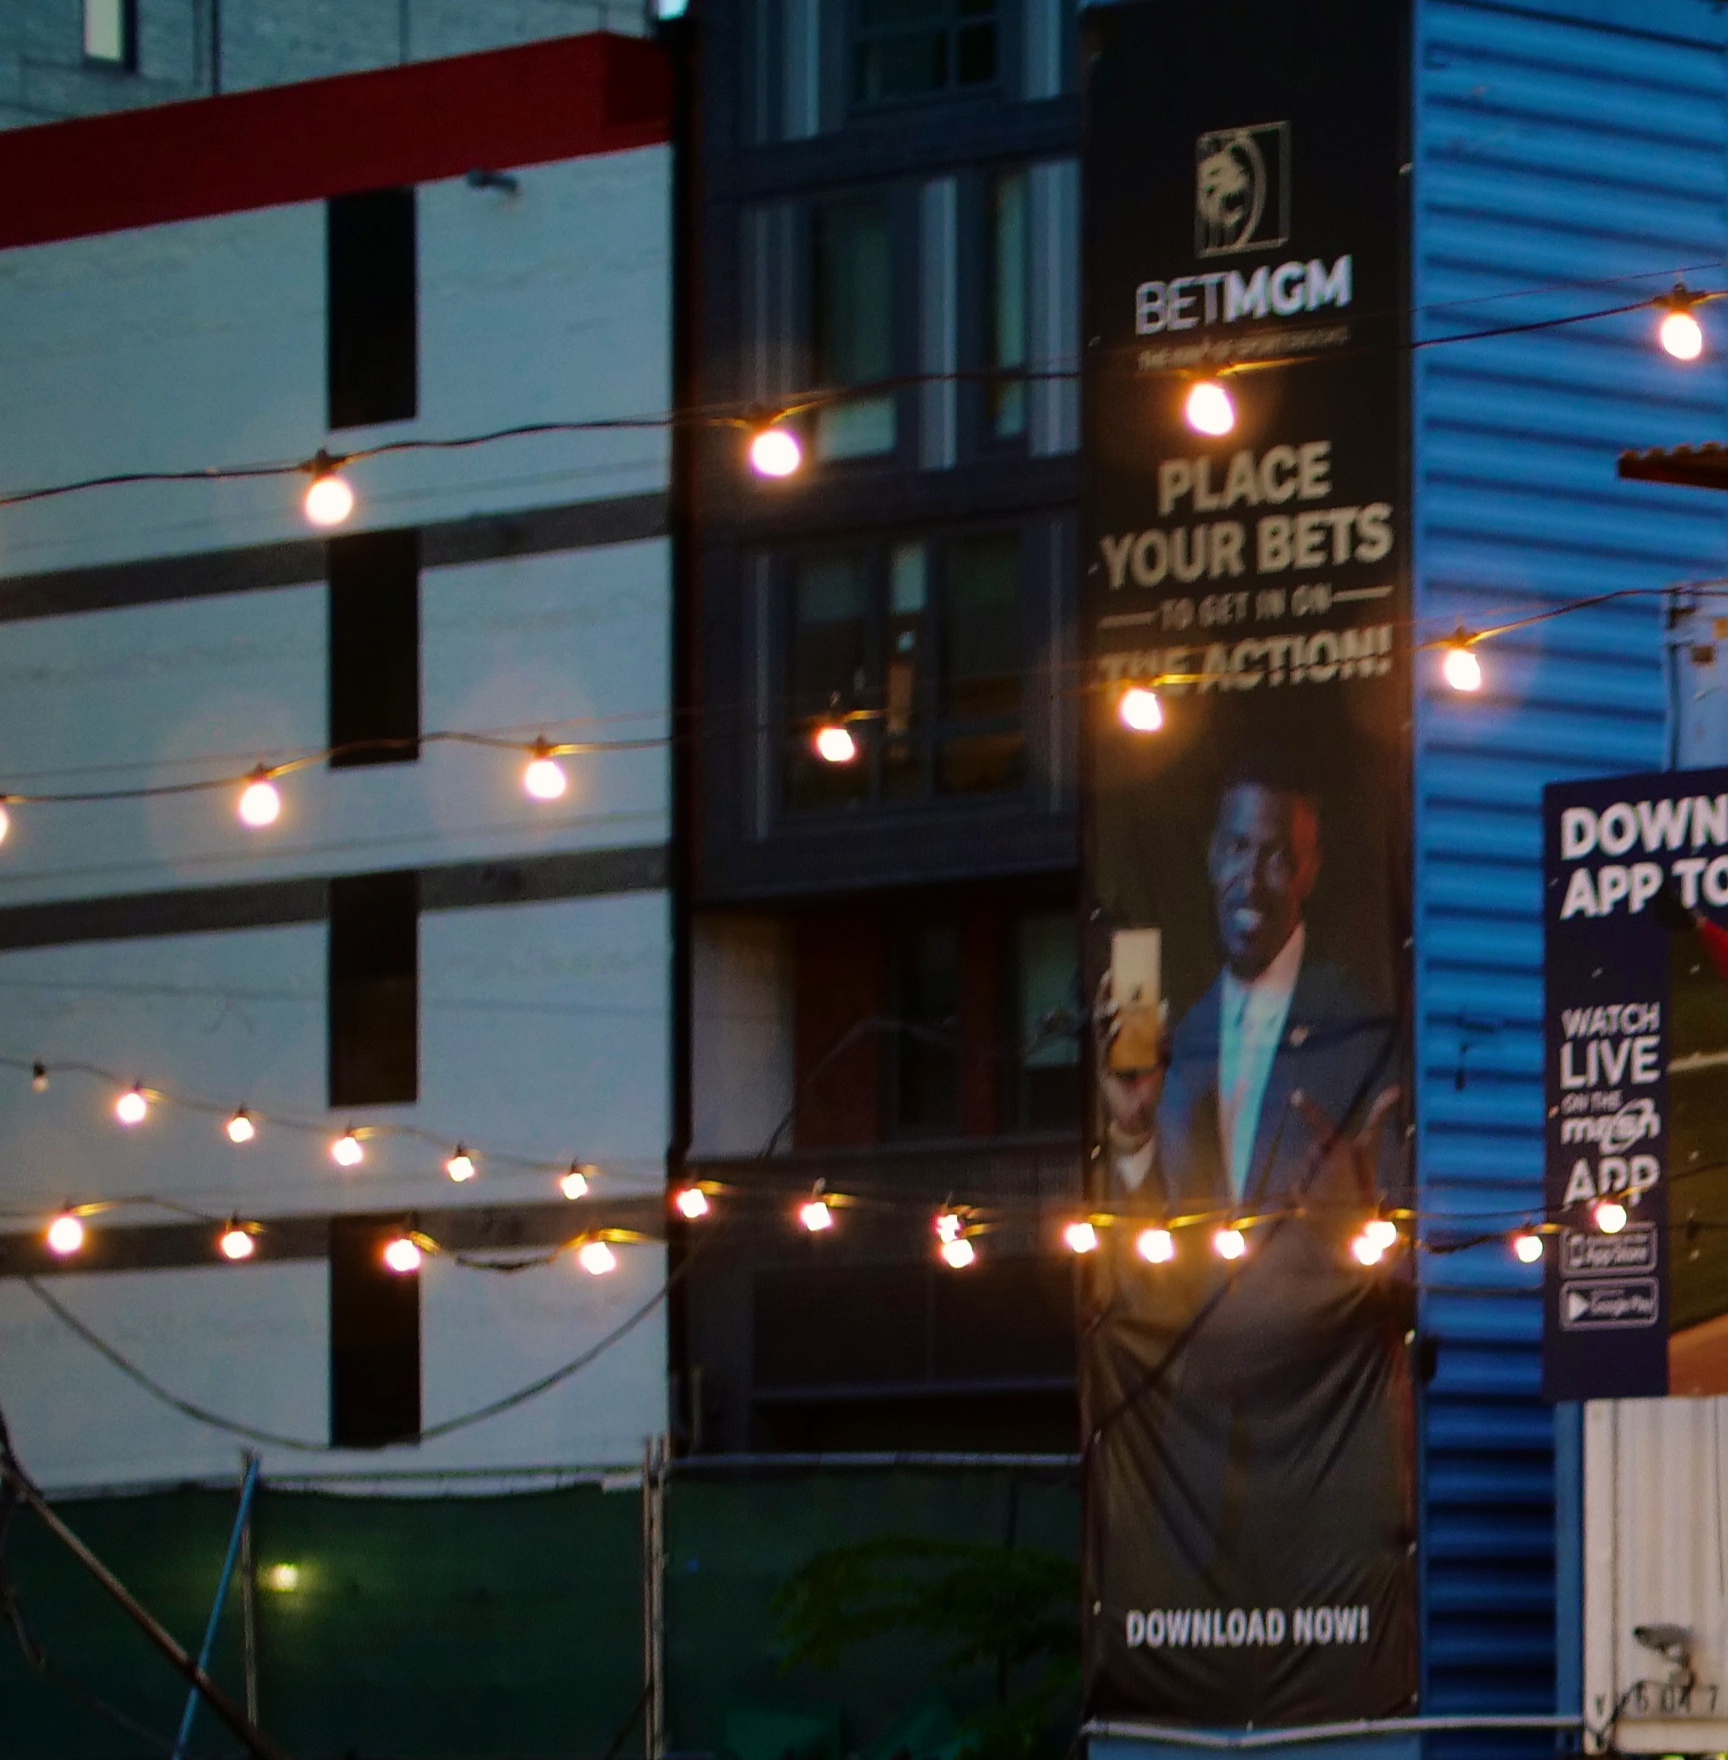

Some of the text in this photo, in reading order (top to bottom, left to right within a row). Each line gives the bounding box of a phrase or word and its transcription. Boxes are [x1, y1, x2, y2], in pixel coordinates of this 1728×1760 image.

[1135, 256, 1353, 335] BETMGM
[1157, 440, 1333, 515] PLACE
[1101, 504, 1394, 589] YOUR BETS
[1560, 863, 1664, 920] APP
[1561, 1000, 1662, 1040] WATCH
[1560, 1036, 1662, 1090] LIVE
[1562, 1154, 1662, 1213] APP
[1126, 1605, 1370, 1648] DOWNLOAD NOW!
